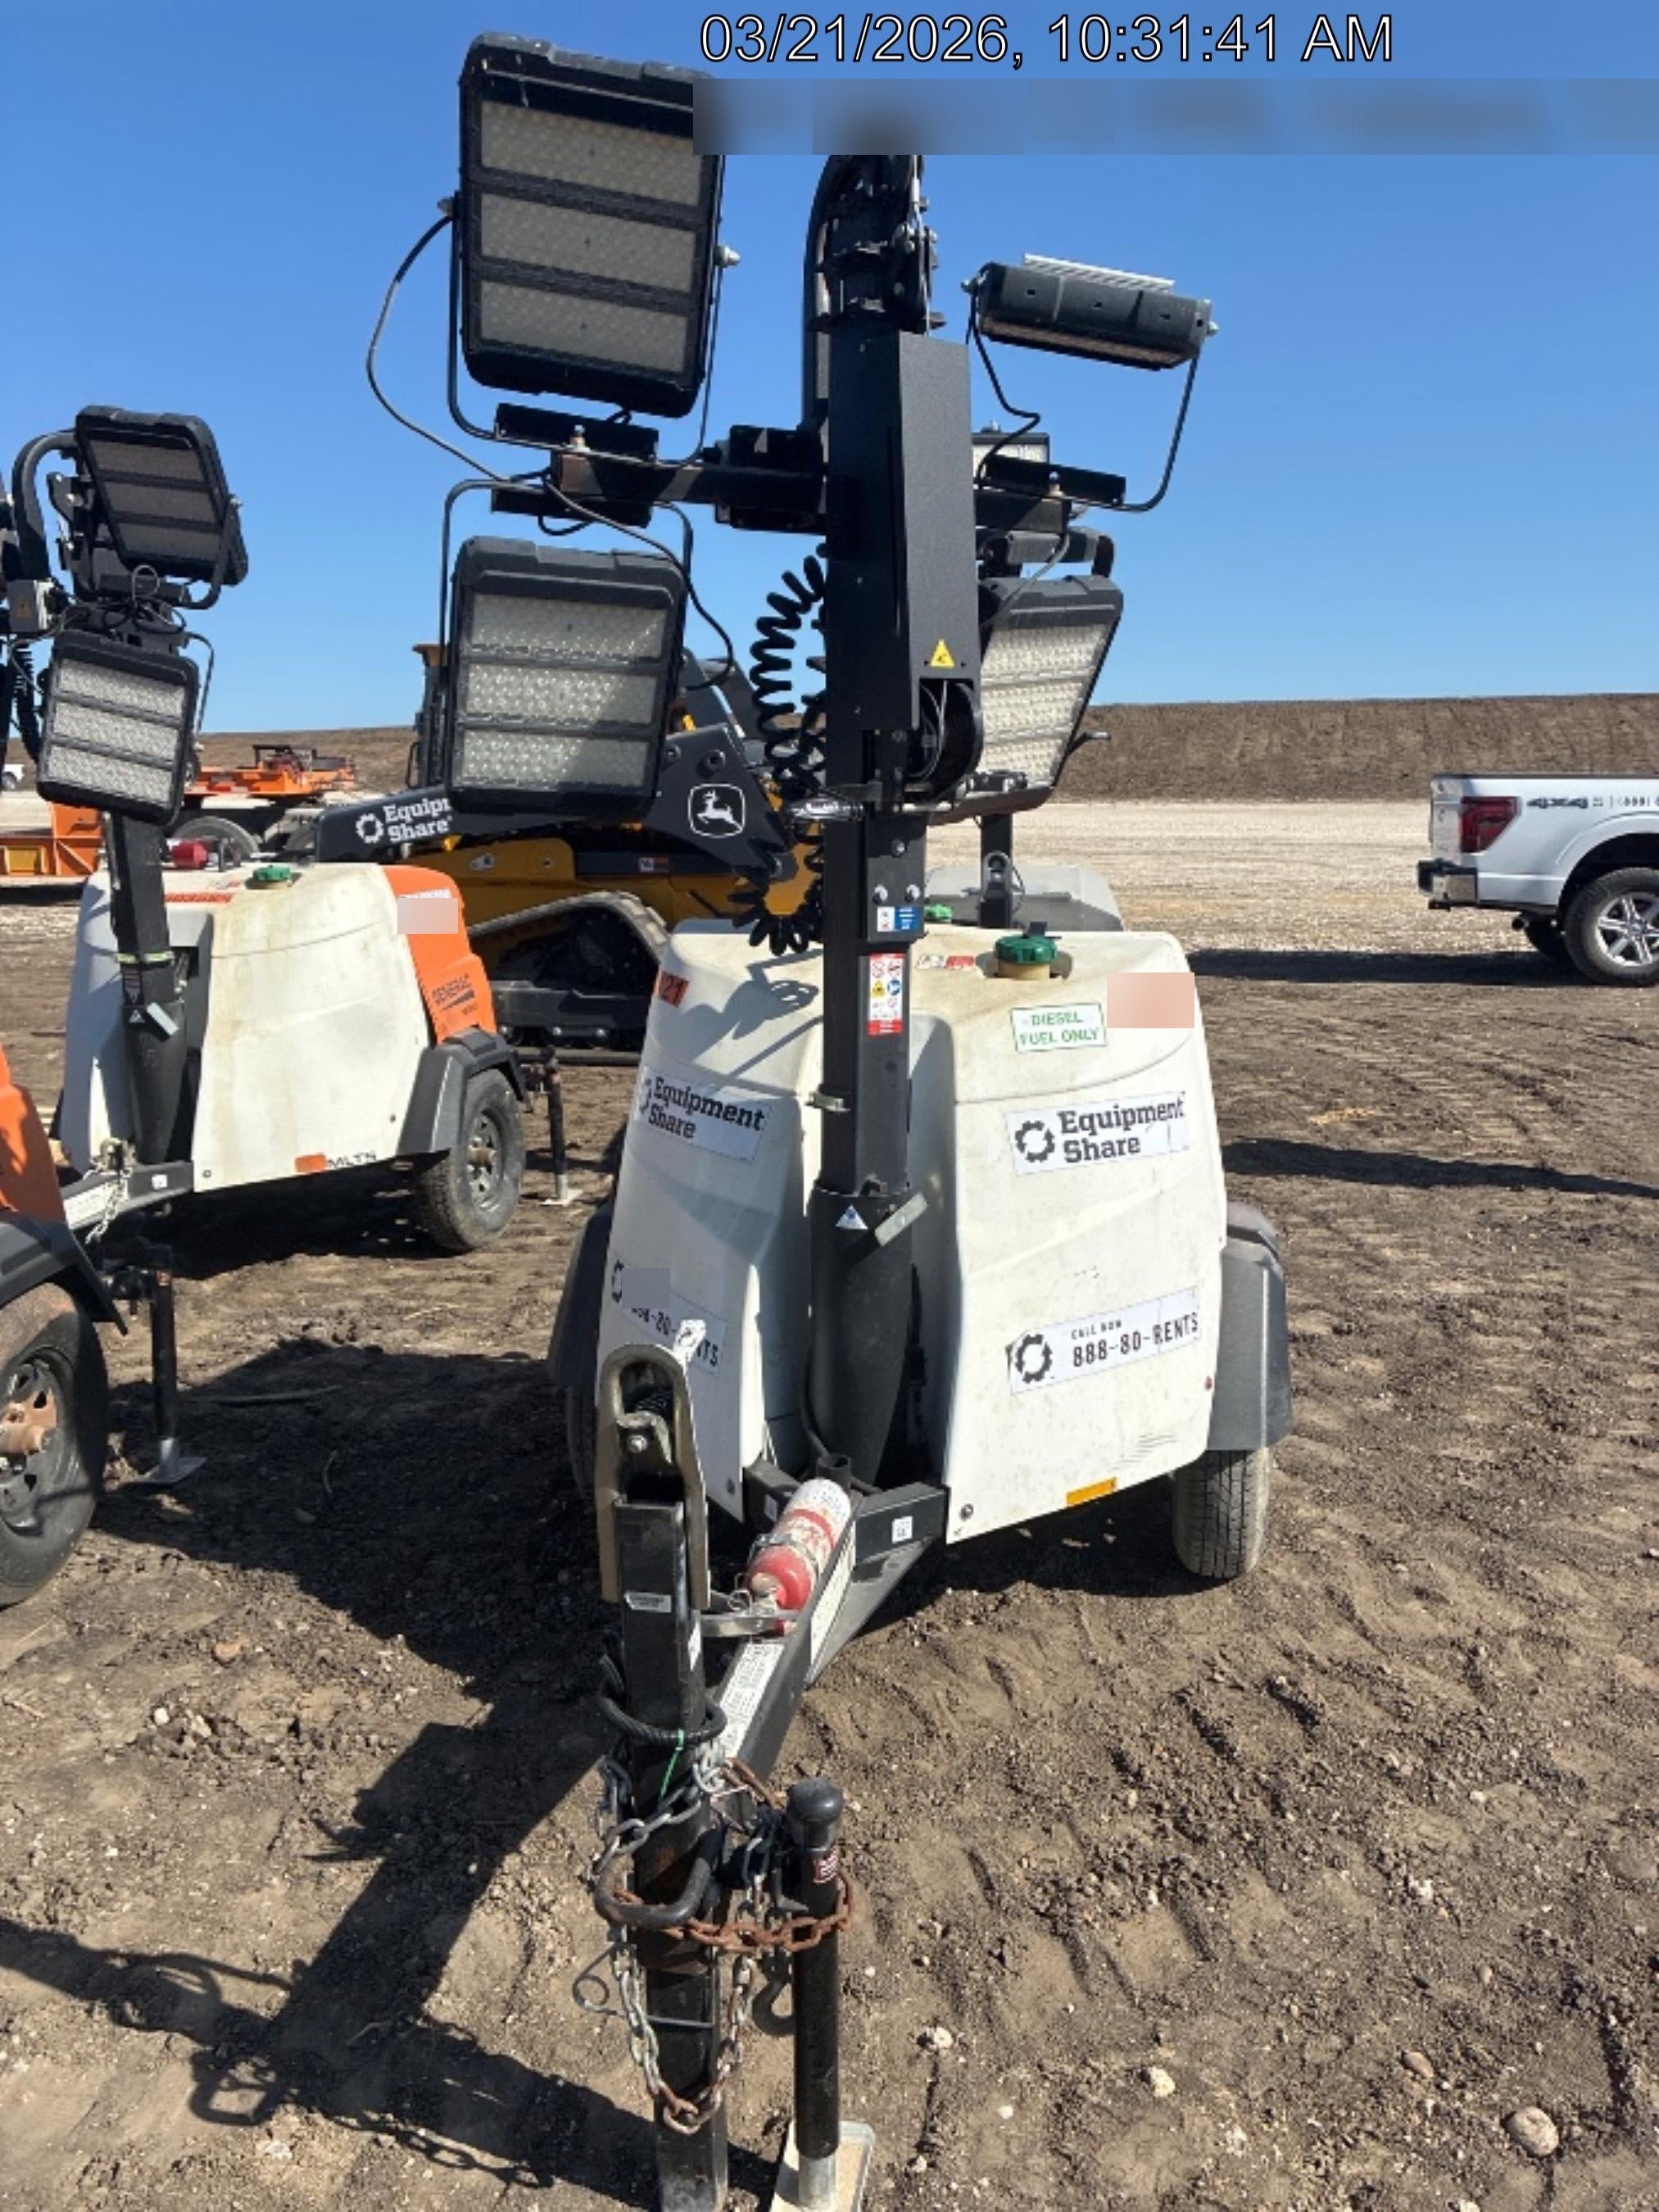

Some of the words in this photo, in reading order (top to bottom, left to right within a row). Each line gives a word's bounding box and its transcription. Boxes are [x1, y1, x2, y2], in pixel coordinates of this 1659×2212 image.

[388, 820, 449, 843] Share
[1030, 1011, 1084, 1026] DIESEL
[1019, 1031, 1058, 1045] FUEL
[1061, 1027, 1099, 1042] ONLY
[653, 1076, 765, 1131] Equipment
[1057, 1095, 1185, 1136] Equipment
[648, 1103, 696, 1139] Share
[1063, 1136, 1141, 1163] Share
[1072, 1311, 1199, 1367] 888-80-RENTS
